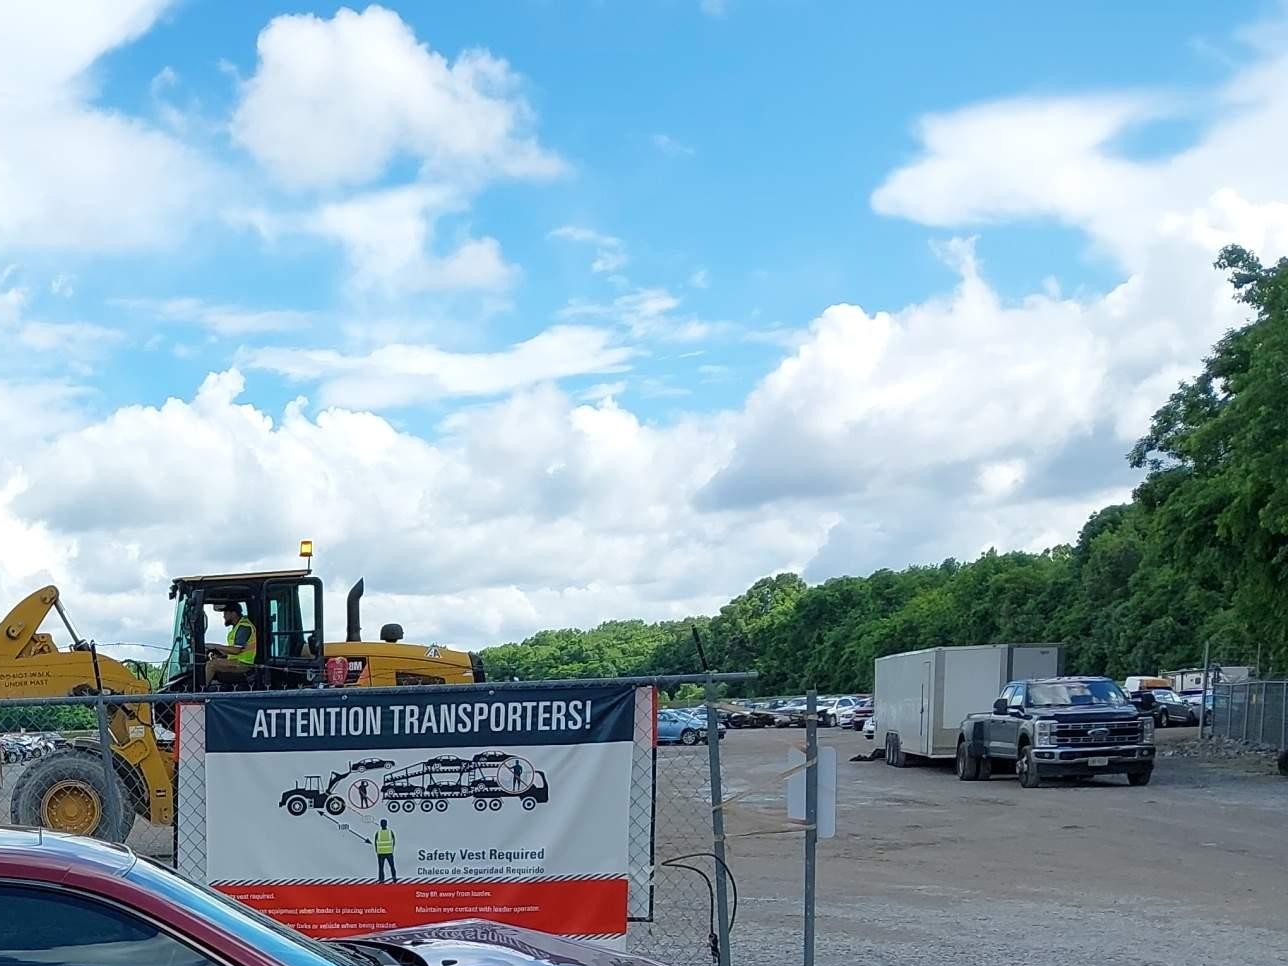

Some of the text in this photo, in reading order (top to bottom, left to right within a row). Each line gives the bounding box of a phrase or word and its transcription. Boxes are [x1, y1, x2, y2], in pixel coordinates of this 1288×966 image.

[251, 700, 592, 738] ATTENTION TRANSPORTERS!
[418, 848, 545, 863] Safety Vest Required
[417, 867, 450, 875] Chaleco
[452, 867, 461, 875] de
[464, 867, 504, 876] Seguridad
[359, 922, 375, 930] being
